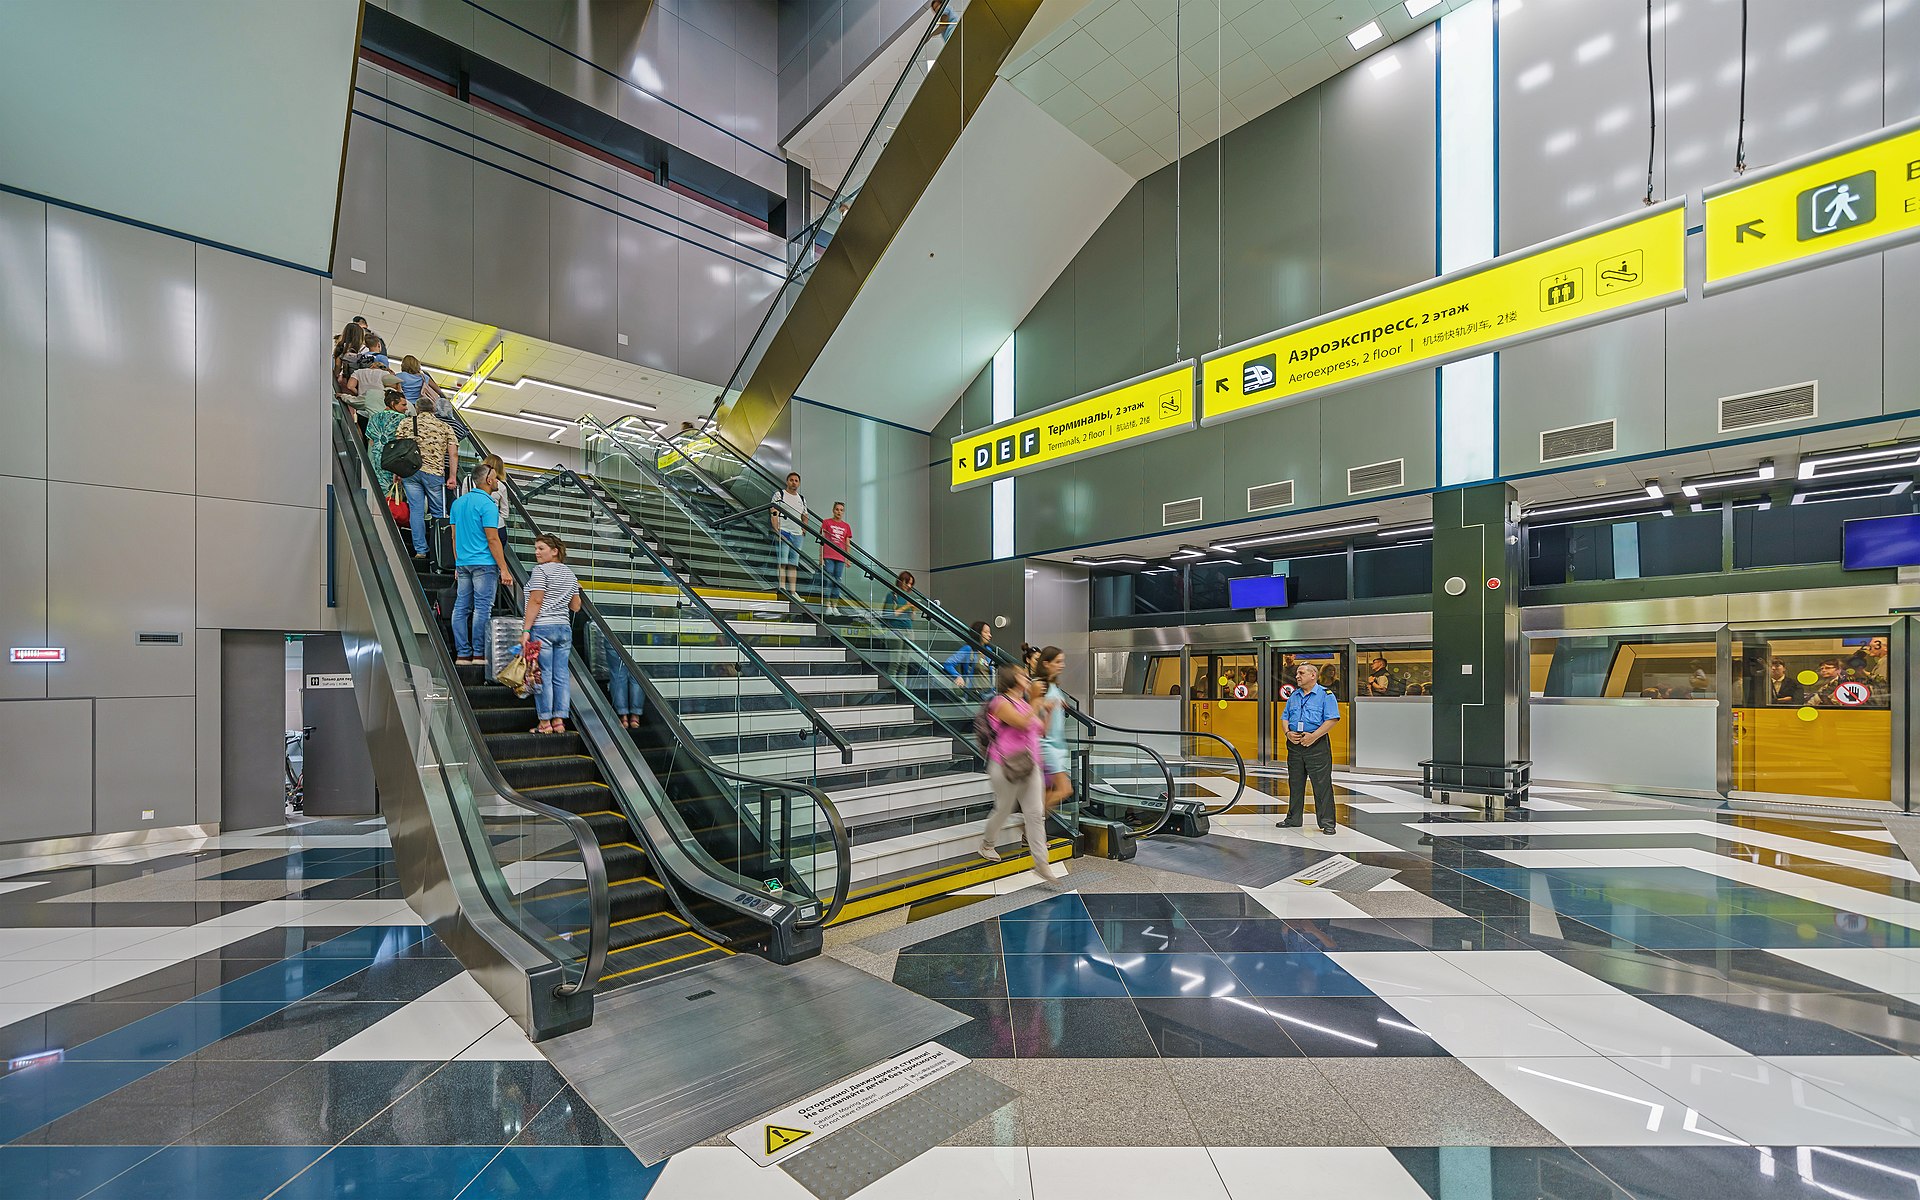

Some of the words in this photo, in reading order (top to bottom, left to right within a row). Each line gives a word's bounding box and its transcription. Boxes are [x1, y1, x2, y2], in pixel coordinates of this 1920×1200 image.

[1288, 317, 1418, 364] Аэроэкспресс,
[1422, 313, 1429, 325] 2
[1433, 303, 1470, 321] этаж
[1288, 357, 1360, 384] Aeroexpress,
[1363, 352, 1370, 363] 2
[1373, 344, 1402, 361] floor
[1048, 410, 1113, 436] Терминалы,
[1115, 407, 1121, 416] 2
[1123, 401, 1145, 414] этаж
[977, 448, 989, 468] D
[1001, 440, 1011, 460] E
[1025, 433, 1035, 453] F
[1048, 436, 1081, 451] Terminals,
[1082, 434, 1087, 442] 2
[1088, 429, 1106, 440] floor
